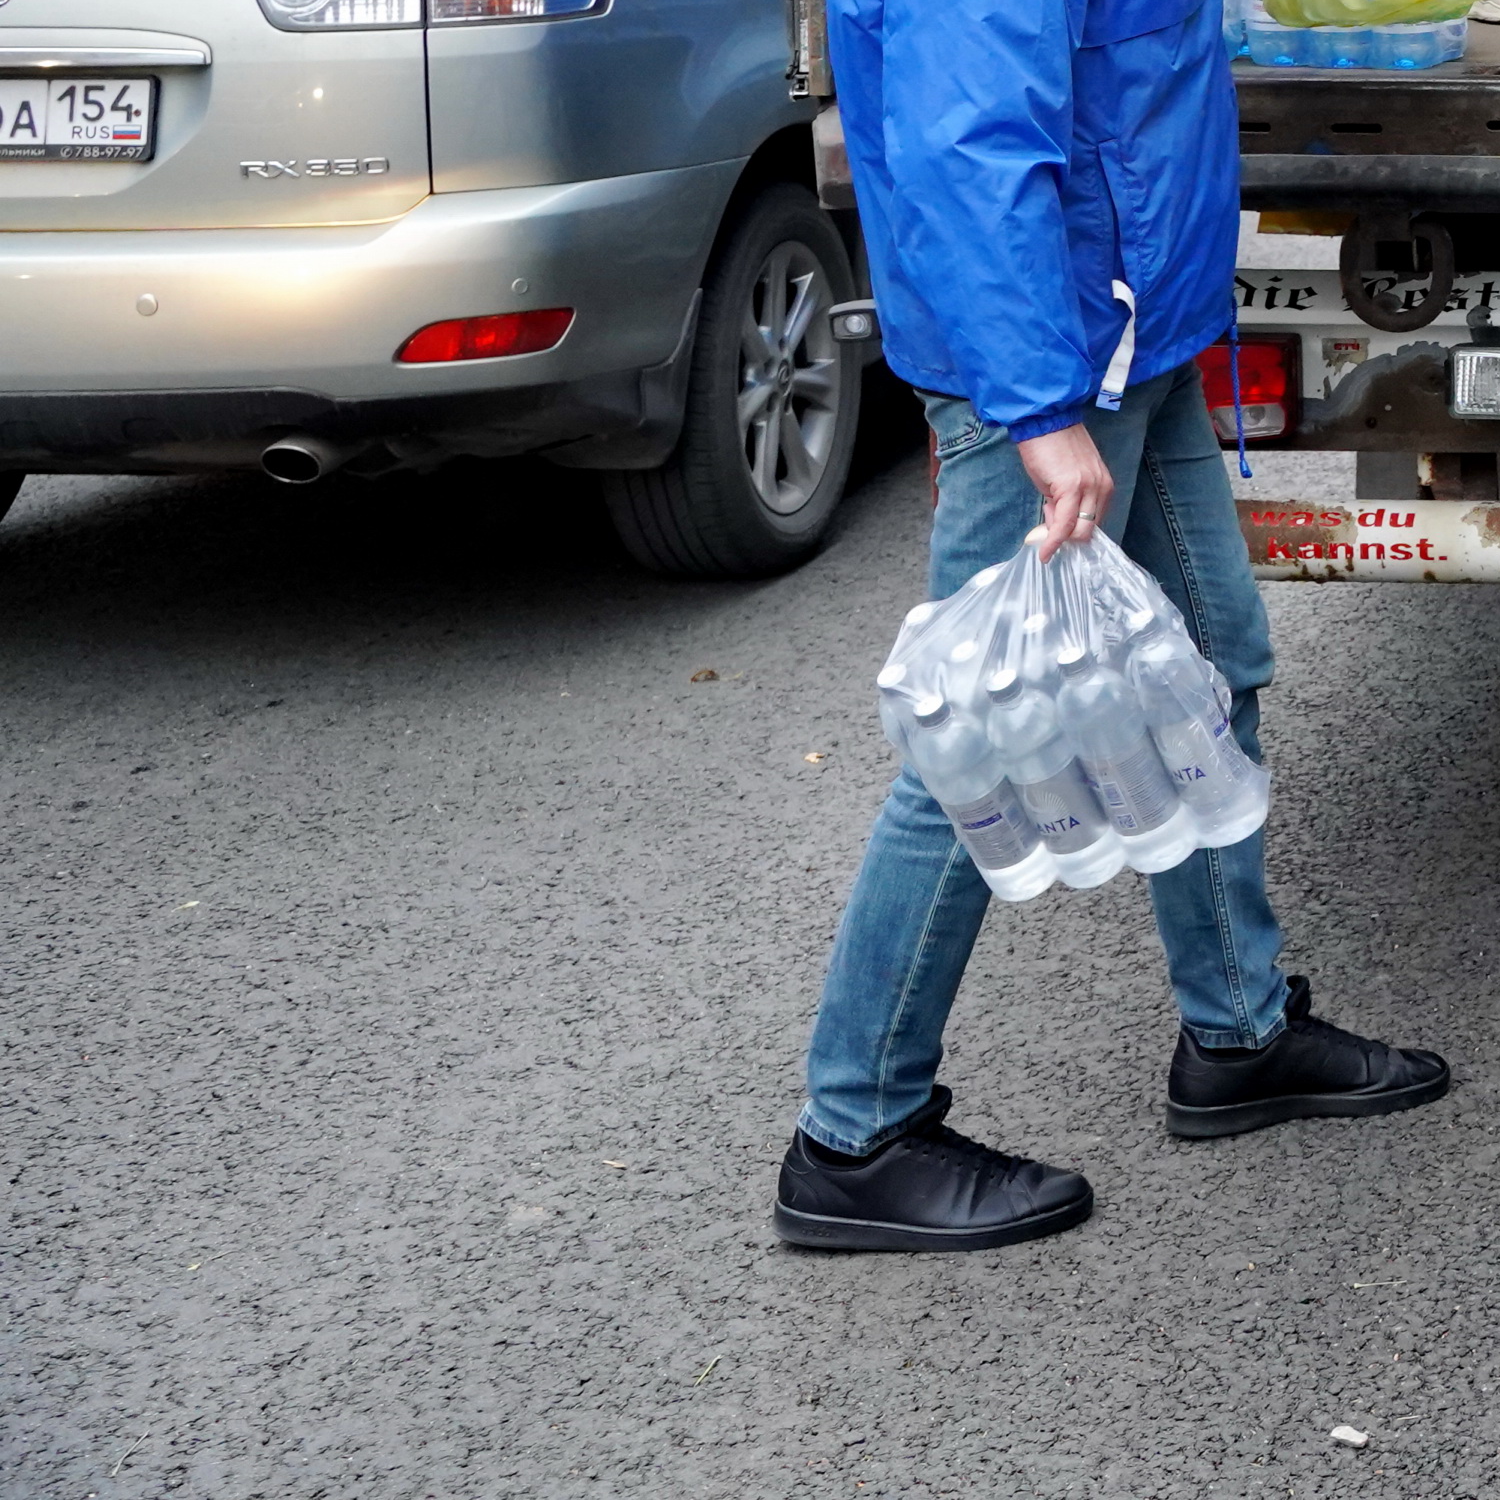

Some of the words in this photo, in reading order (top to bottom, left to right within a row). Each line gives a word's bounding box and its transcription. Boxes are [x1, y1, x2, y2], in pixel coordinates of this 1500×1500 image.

[57, 85, 133, 122] 154
[71, 125, 110, 139] RUS
[75, 146, 144, 159] 788-97-97
[239, 160, 300, 179] RX
[1250, 510, 1342, 528] was
[1356, 508, 1416, 528] du
[1266, 536, 1449, 561] kannst.
